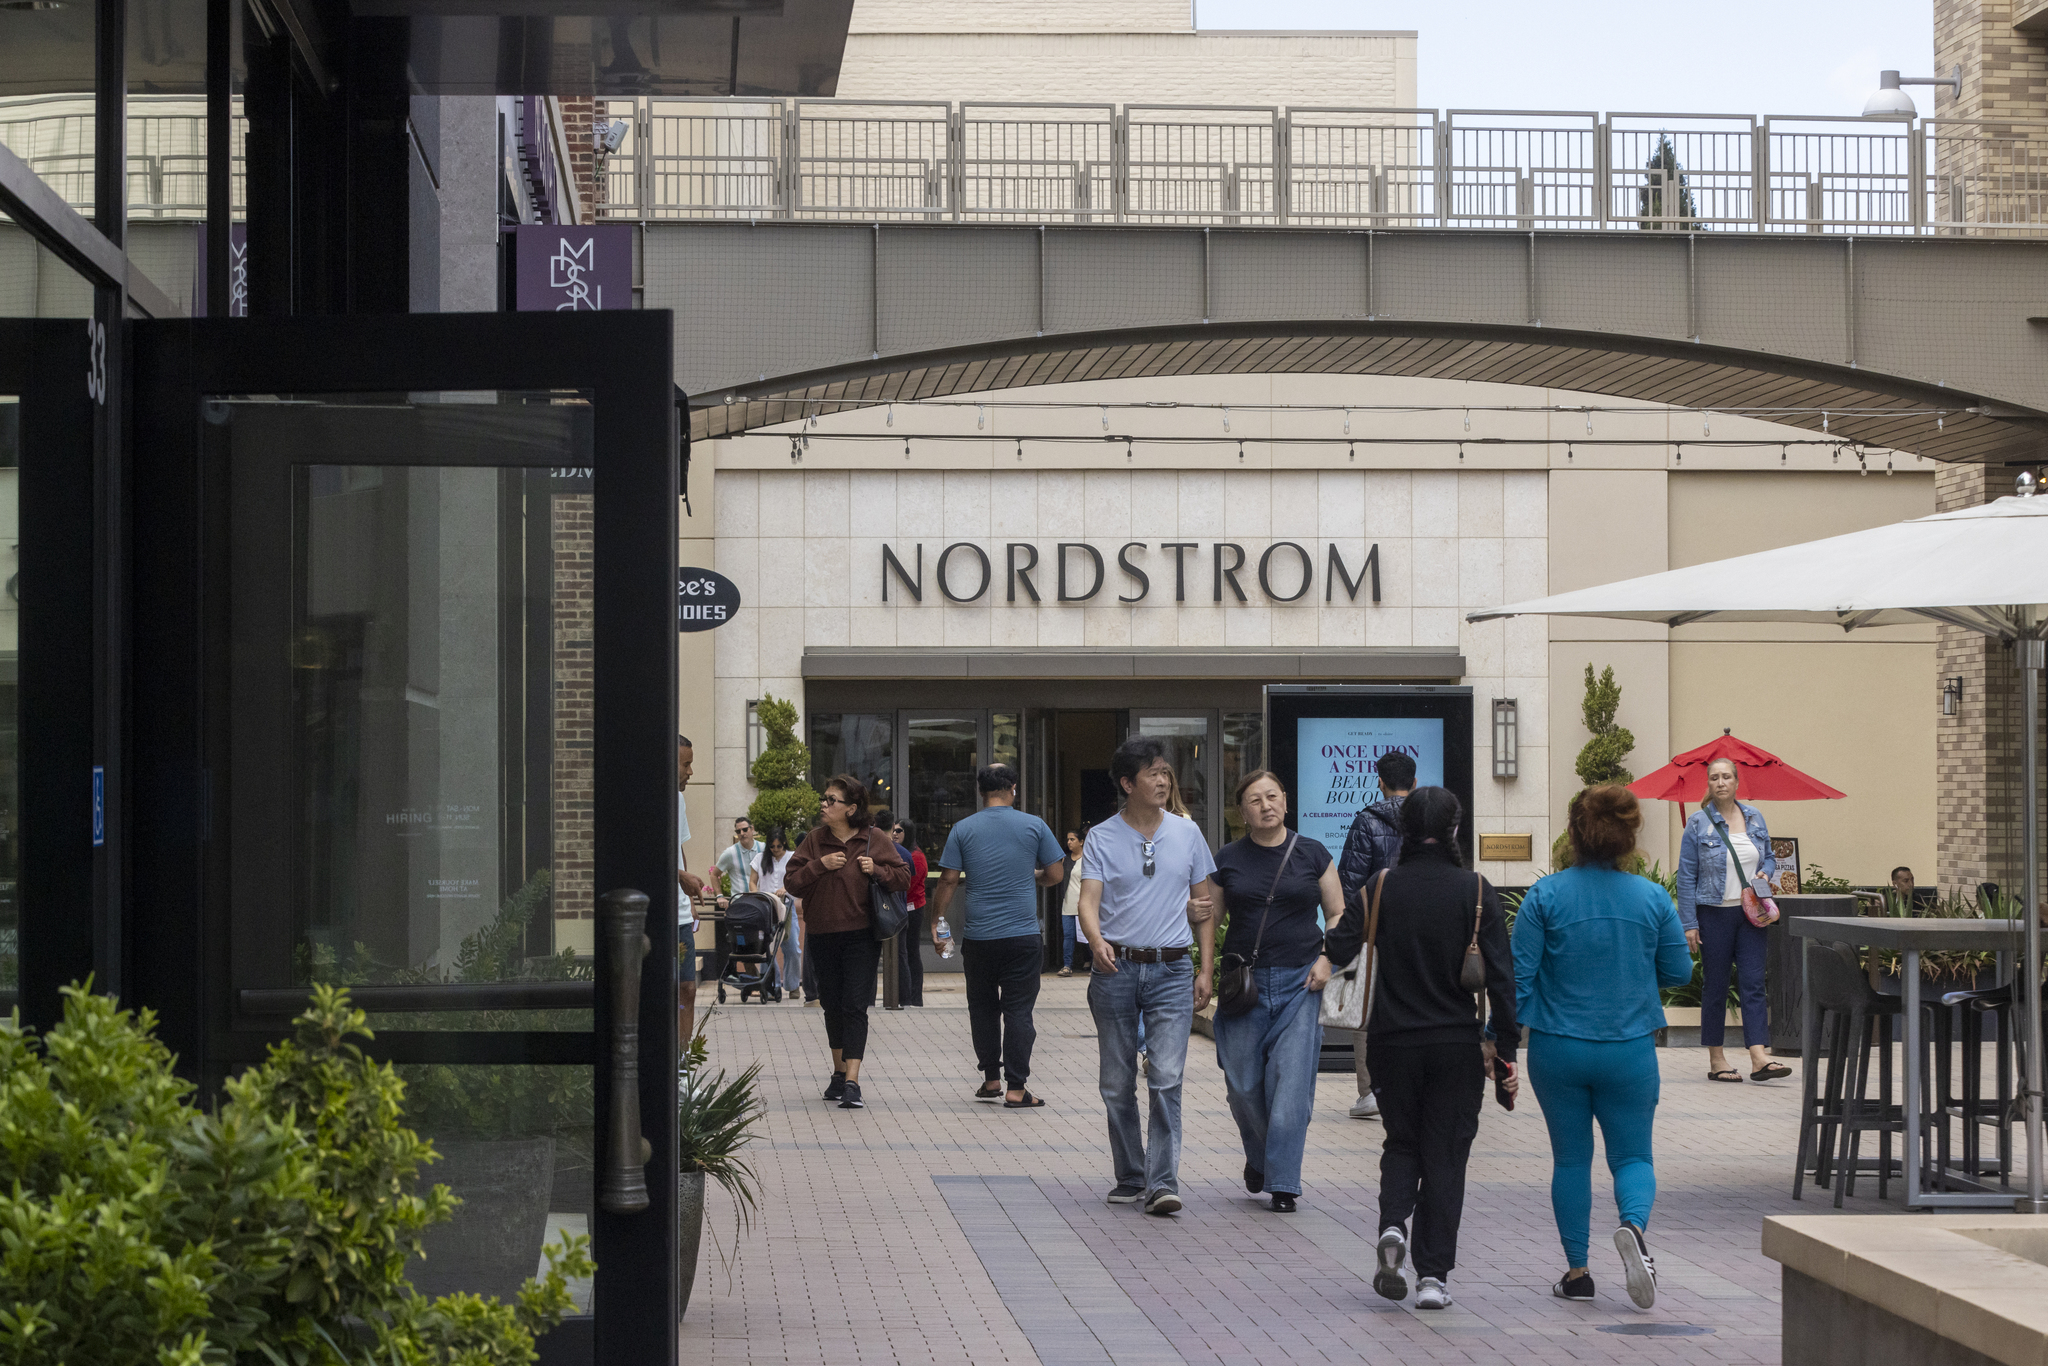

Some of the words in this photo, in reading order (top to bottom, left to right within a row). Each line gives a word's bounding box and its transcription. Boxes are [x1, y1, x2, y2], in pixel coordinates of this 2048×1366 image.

[87, 316, 106, 406] 33
[881, 541, 1382, 602] NORDSTROM
[679, 577, 716, 596] ee's
[679, 604, 727, 620] DIES
[1321, 744, 1368, 759] ONCE
[1330, 760, 1340, 774] A
[1345, 760, 1379, 774] STR
[1331, 775, 1381, 789] BEAUT
[386, 812, 432, 824] HIRING
